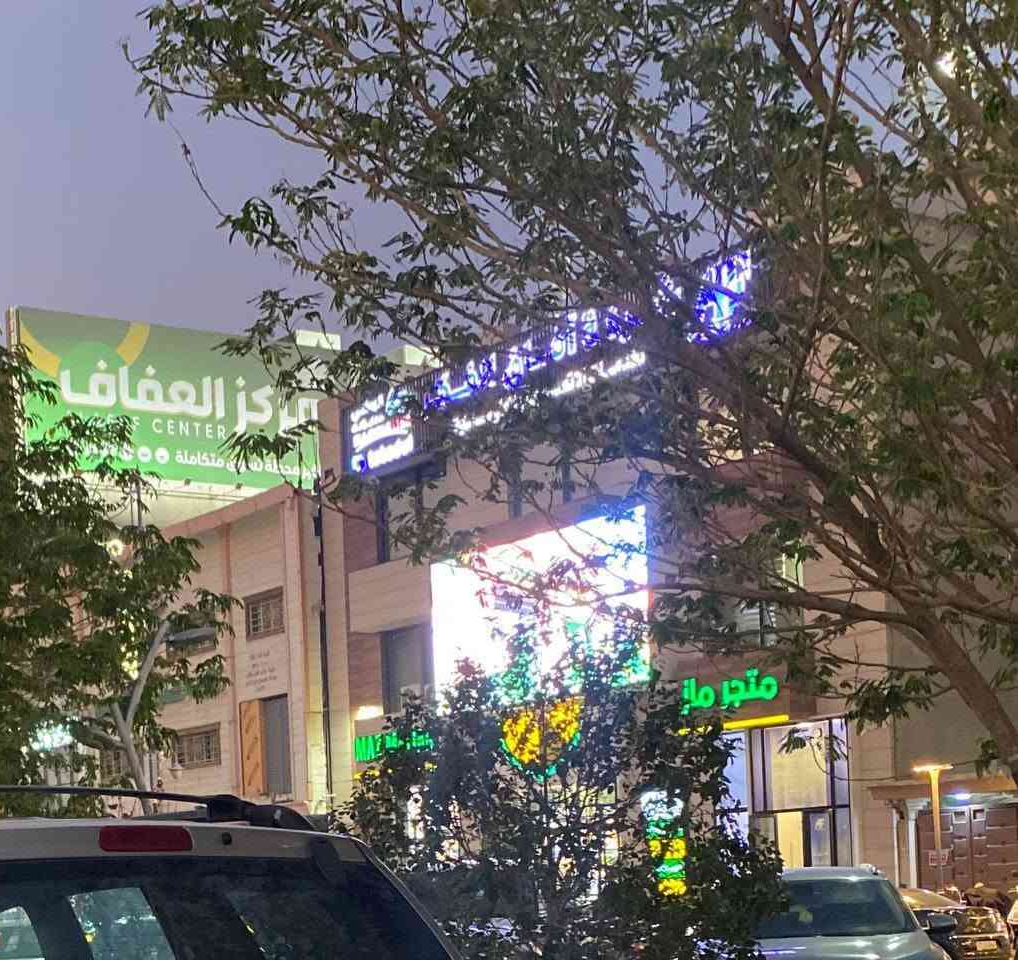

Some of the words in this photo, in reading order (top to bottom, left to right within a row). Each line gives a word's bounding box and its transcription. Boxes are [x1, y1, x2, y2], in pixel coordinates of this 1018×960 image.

[59, 359, 225, 421] العفاف
[234, 375, 319, 439] مركز
[151, 417, 227, 440] CENTER
[721, 667, 779, 709] متجر
